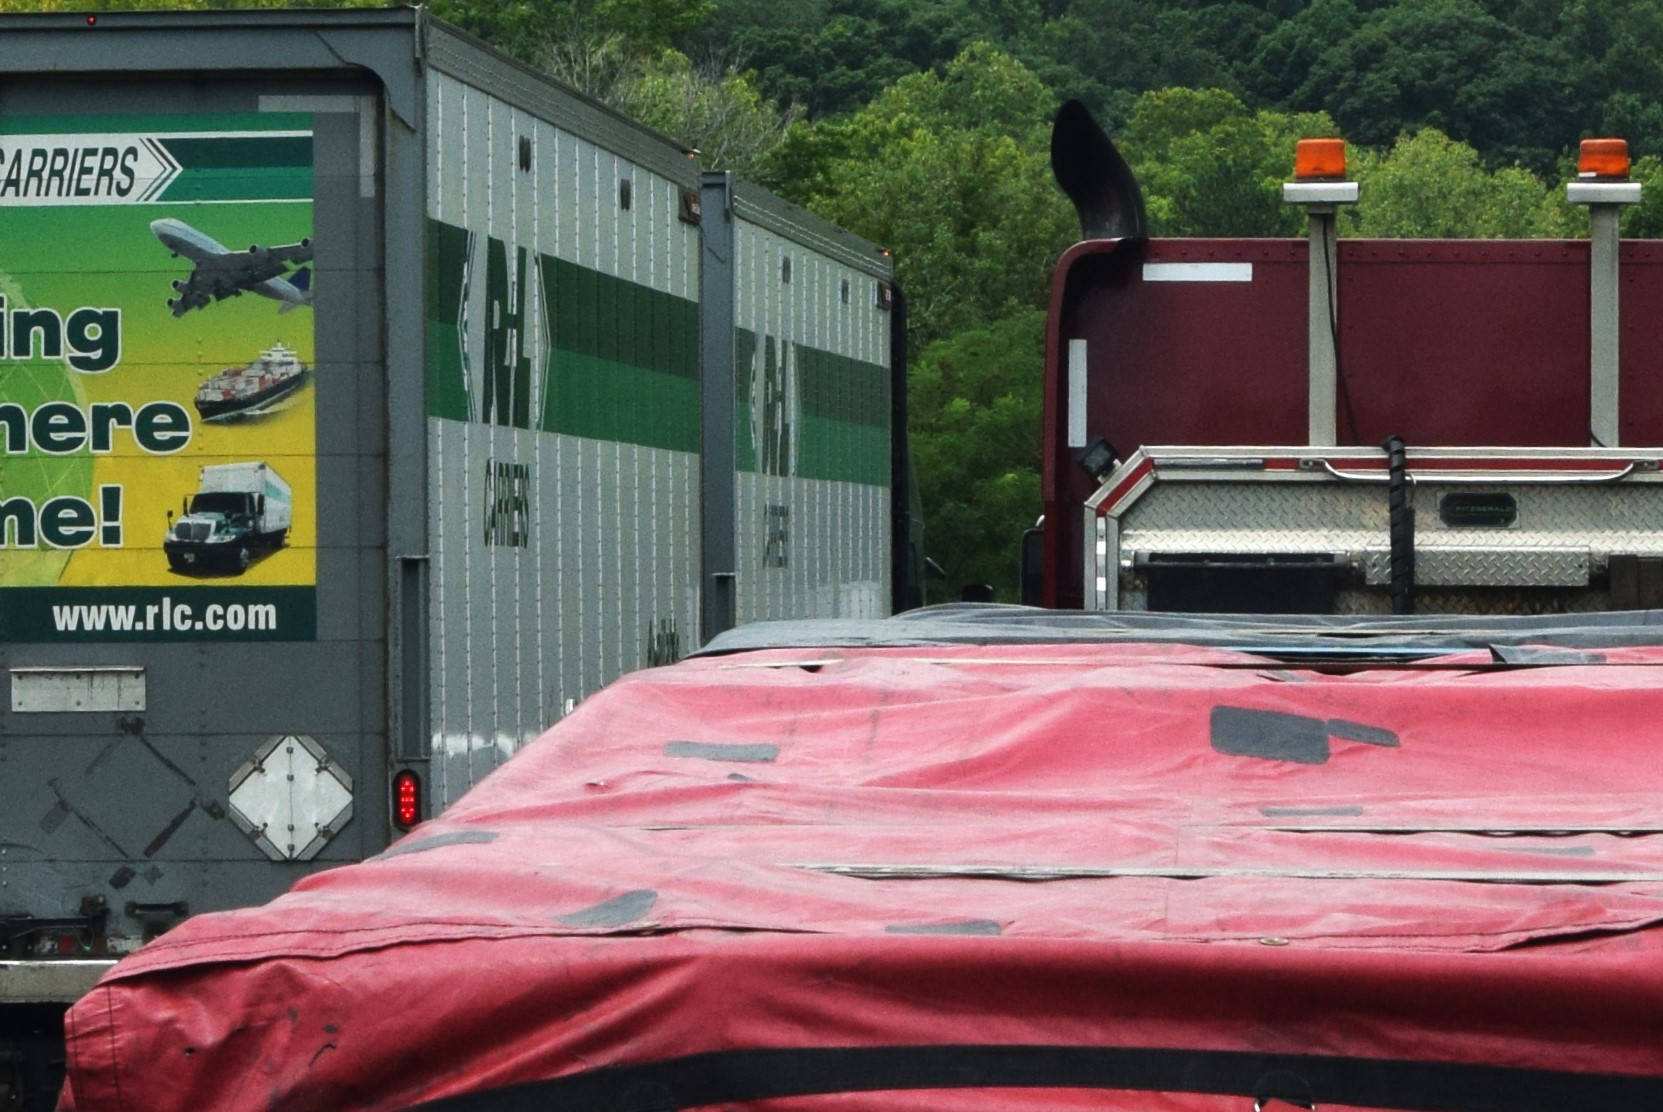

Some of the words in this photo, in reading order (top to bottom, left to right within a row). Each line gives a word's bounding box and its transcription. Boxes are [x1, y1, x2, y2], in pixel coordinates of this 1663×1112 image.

[0, 146, 139, 198] ARRIERS
[0, 293, 122, 374] ng
[52, 597, 277, 631] www.rlc.com
